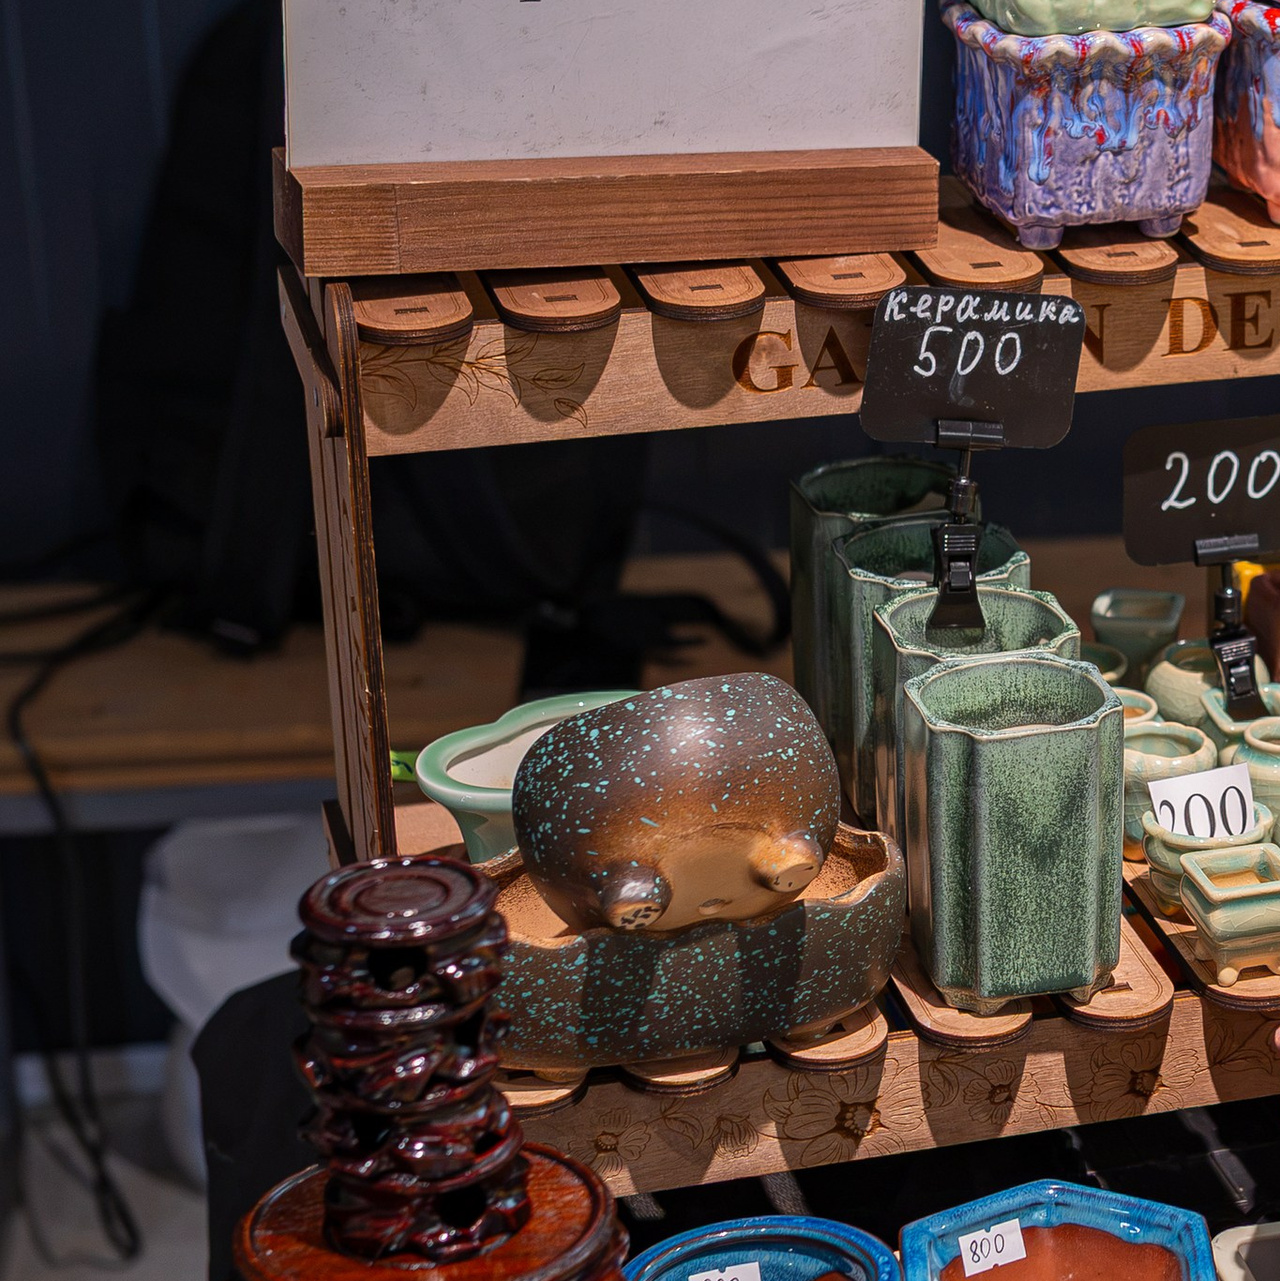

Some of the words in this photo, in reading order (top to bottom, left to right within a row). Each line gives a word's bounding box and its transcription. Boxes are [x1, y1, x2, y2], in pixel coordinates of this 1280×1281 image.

[732, 303, 1112, 395] GAN
[913, 325, 1022, 378] 500
[969, 1233, 1005, 1264] 800
